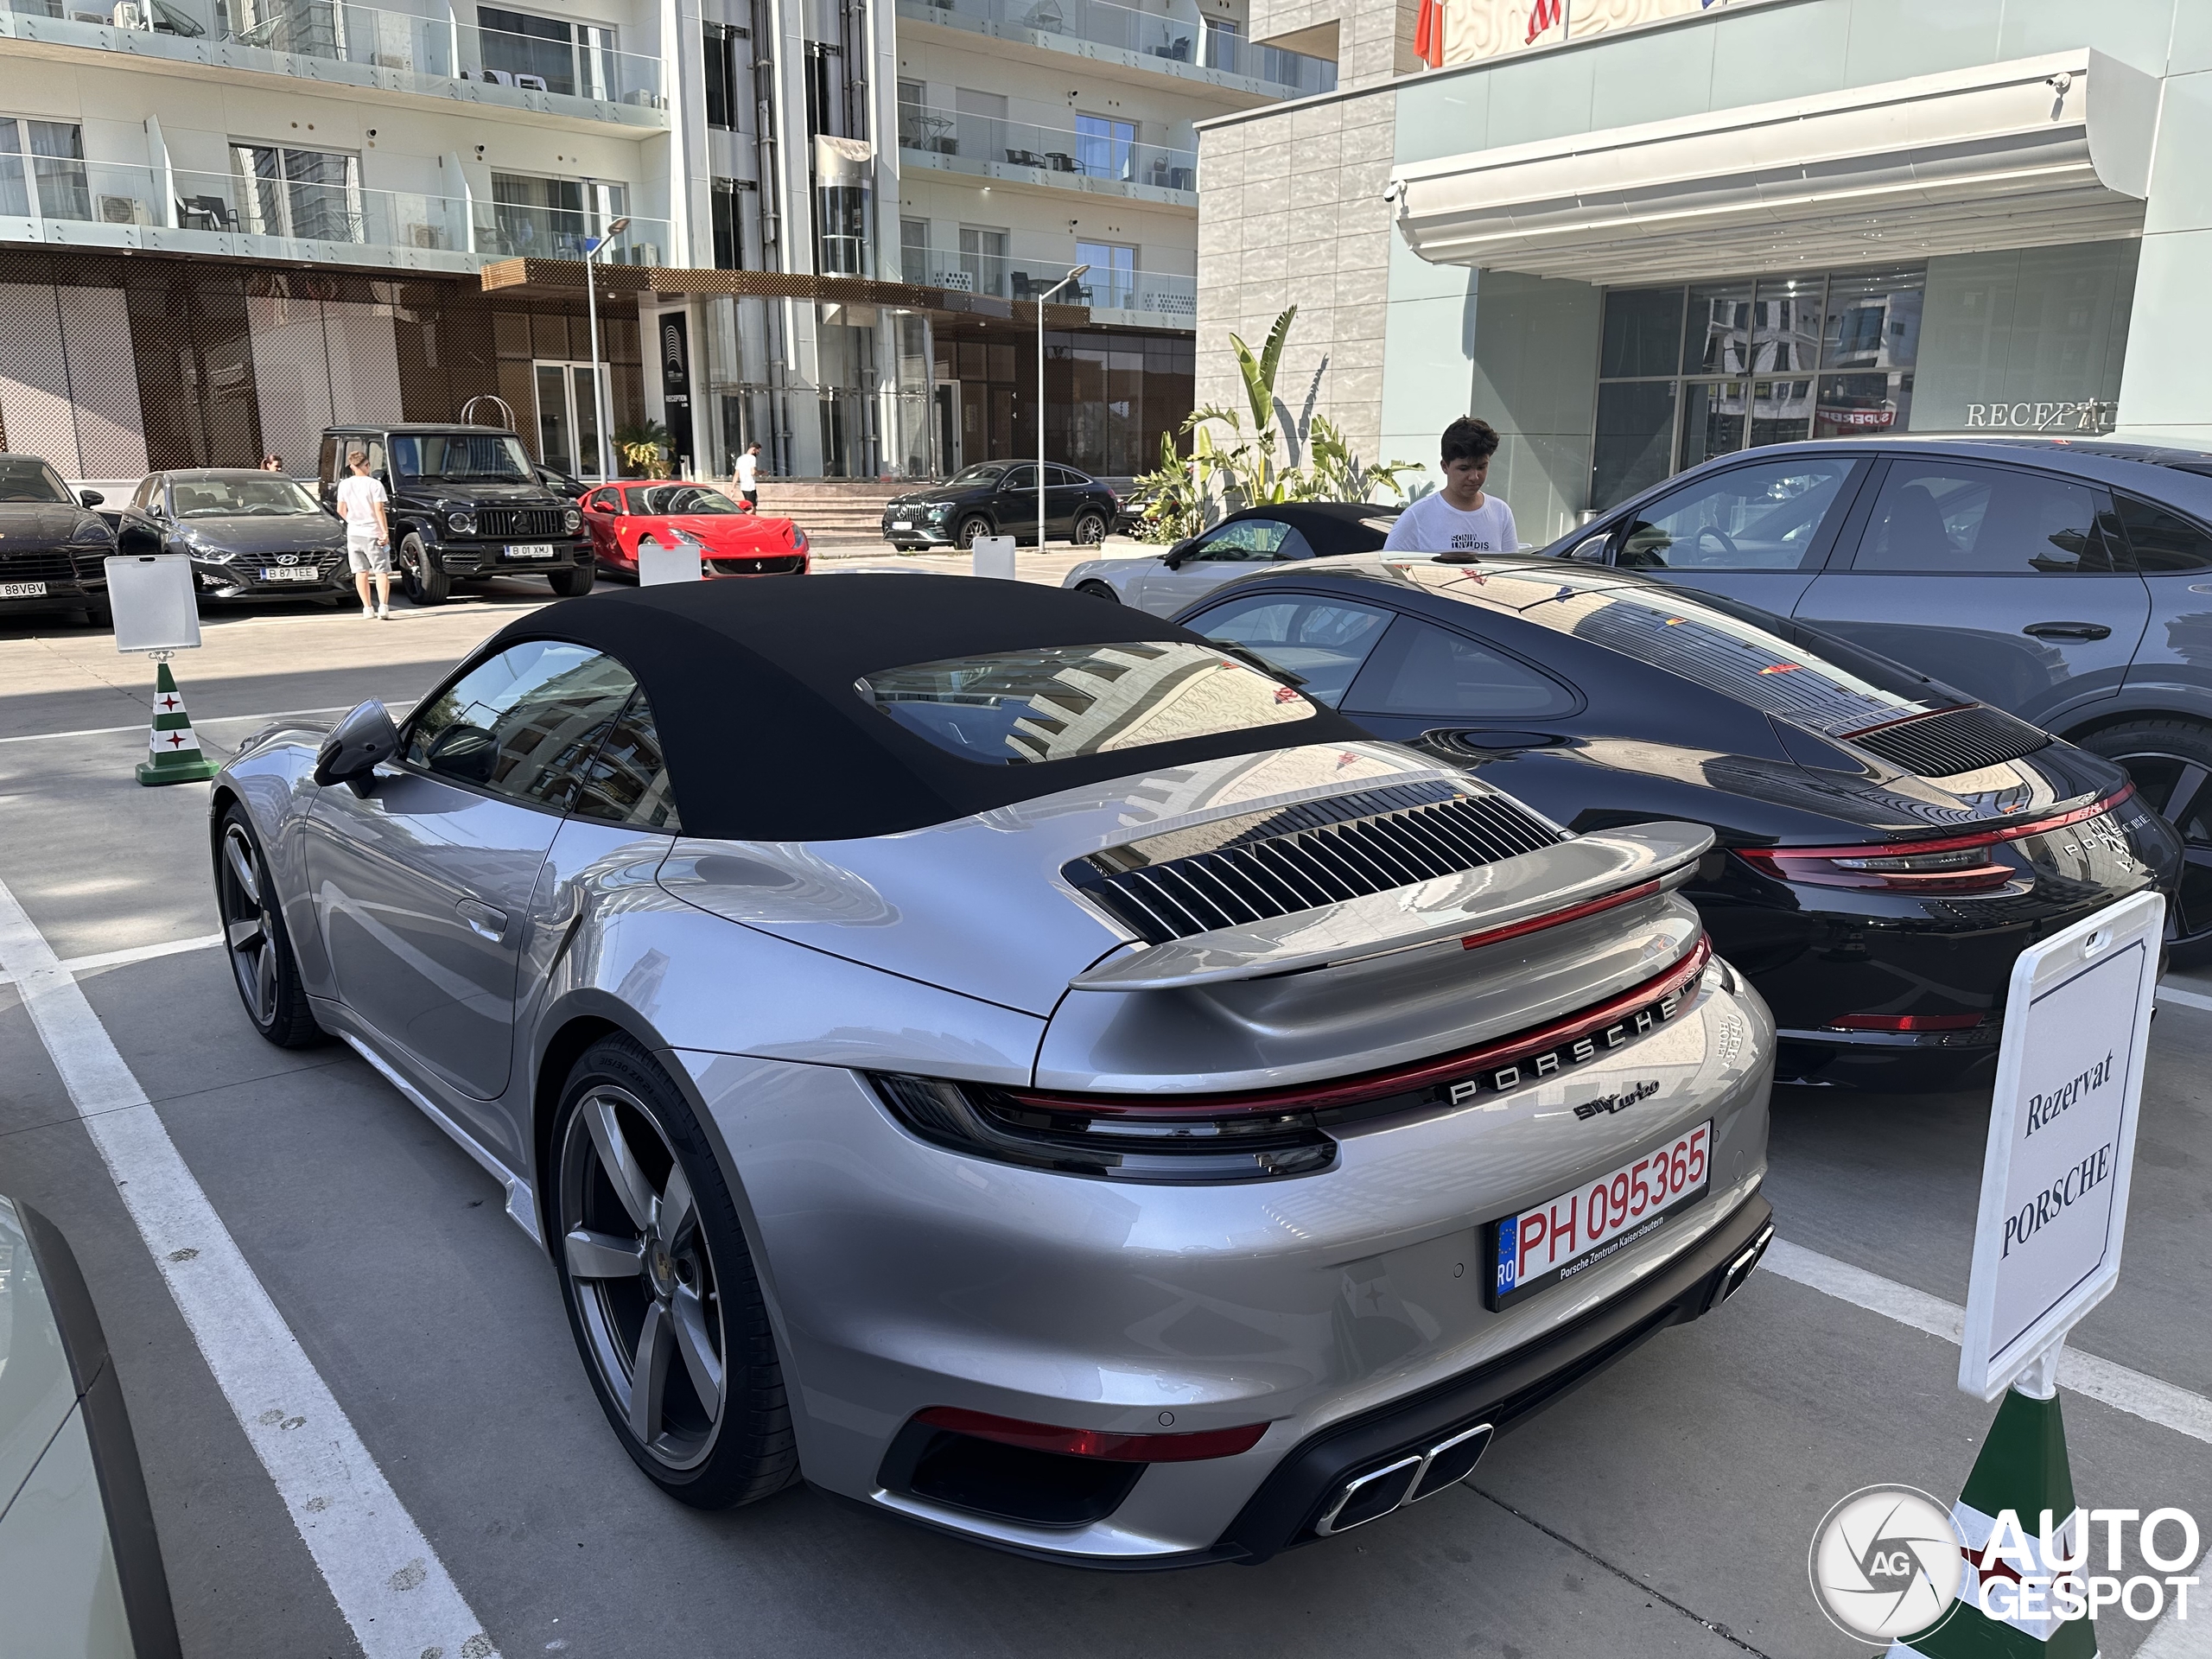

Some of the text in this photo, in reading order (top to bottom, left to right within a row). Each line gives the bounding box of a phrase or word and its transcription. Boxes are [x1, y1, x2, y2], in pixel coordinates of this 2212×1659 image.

[270, 567, 313, 578] B 87 TEE
[512, 545, 549, 555] B 01 XMJ
[1450, 997, 1677, 1106] PORSCHE
[2024, 1048, 2113, 1140] Rezervat
[1497, 1128, 1706, 1287] RO PH 095365
[2000, 1141, 2111, 1261] PORSCHE
[1560, 1216, 1664, 1281] Porsche Zentrum Kaiserslautern
